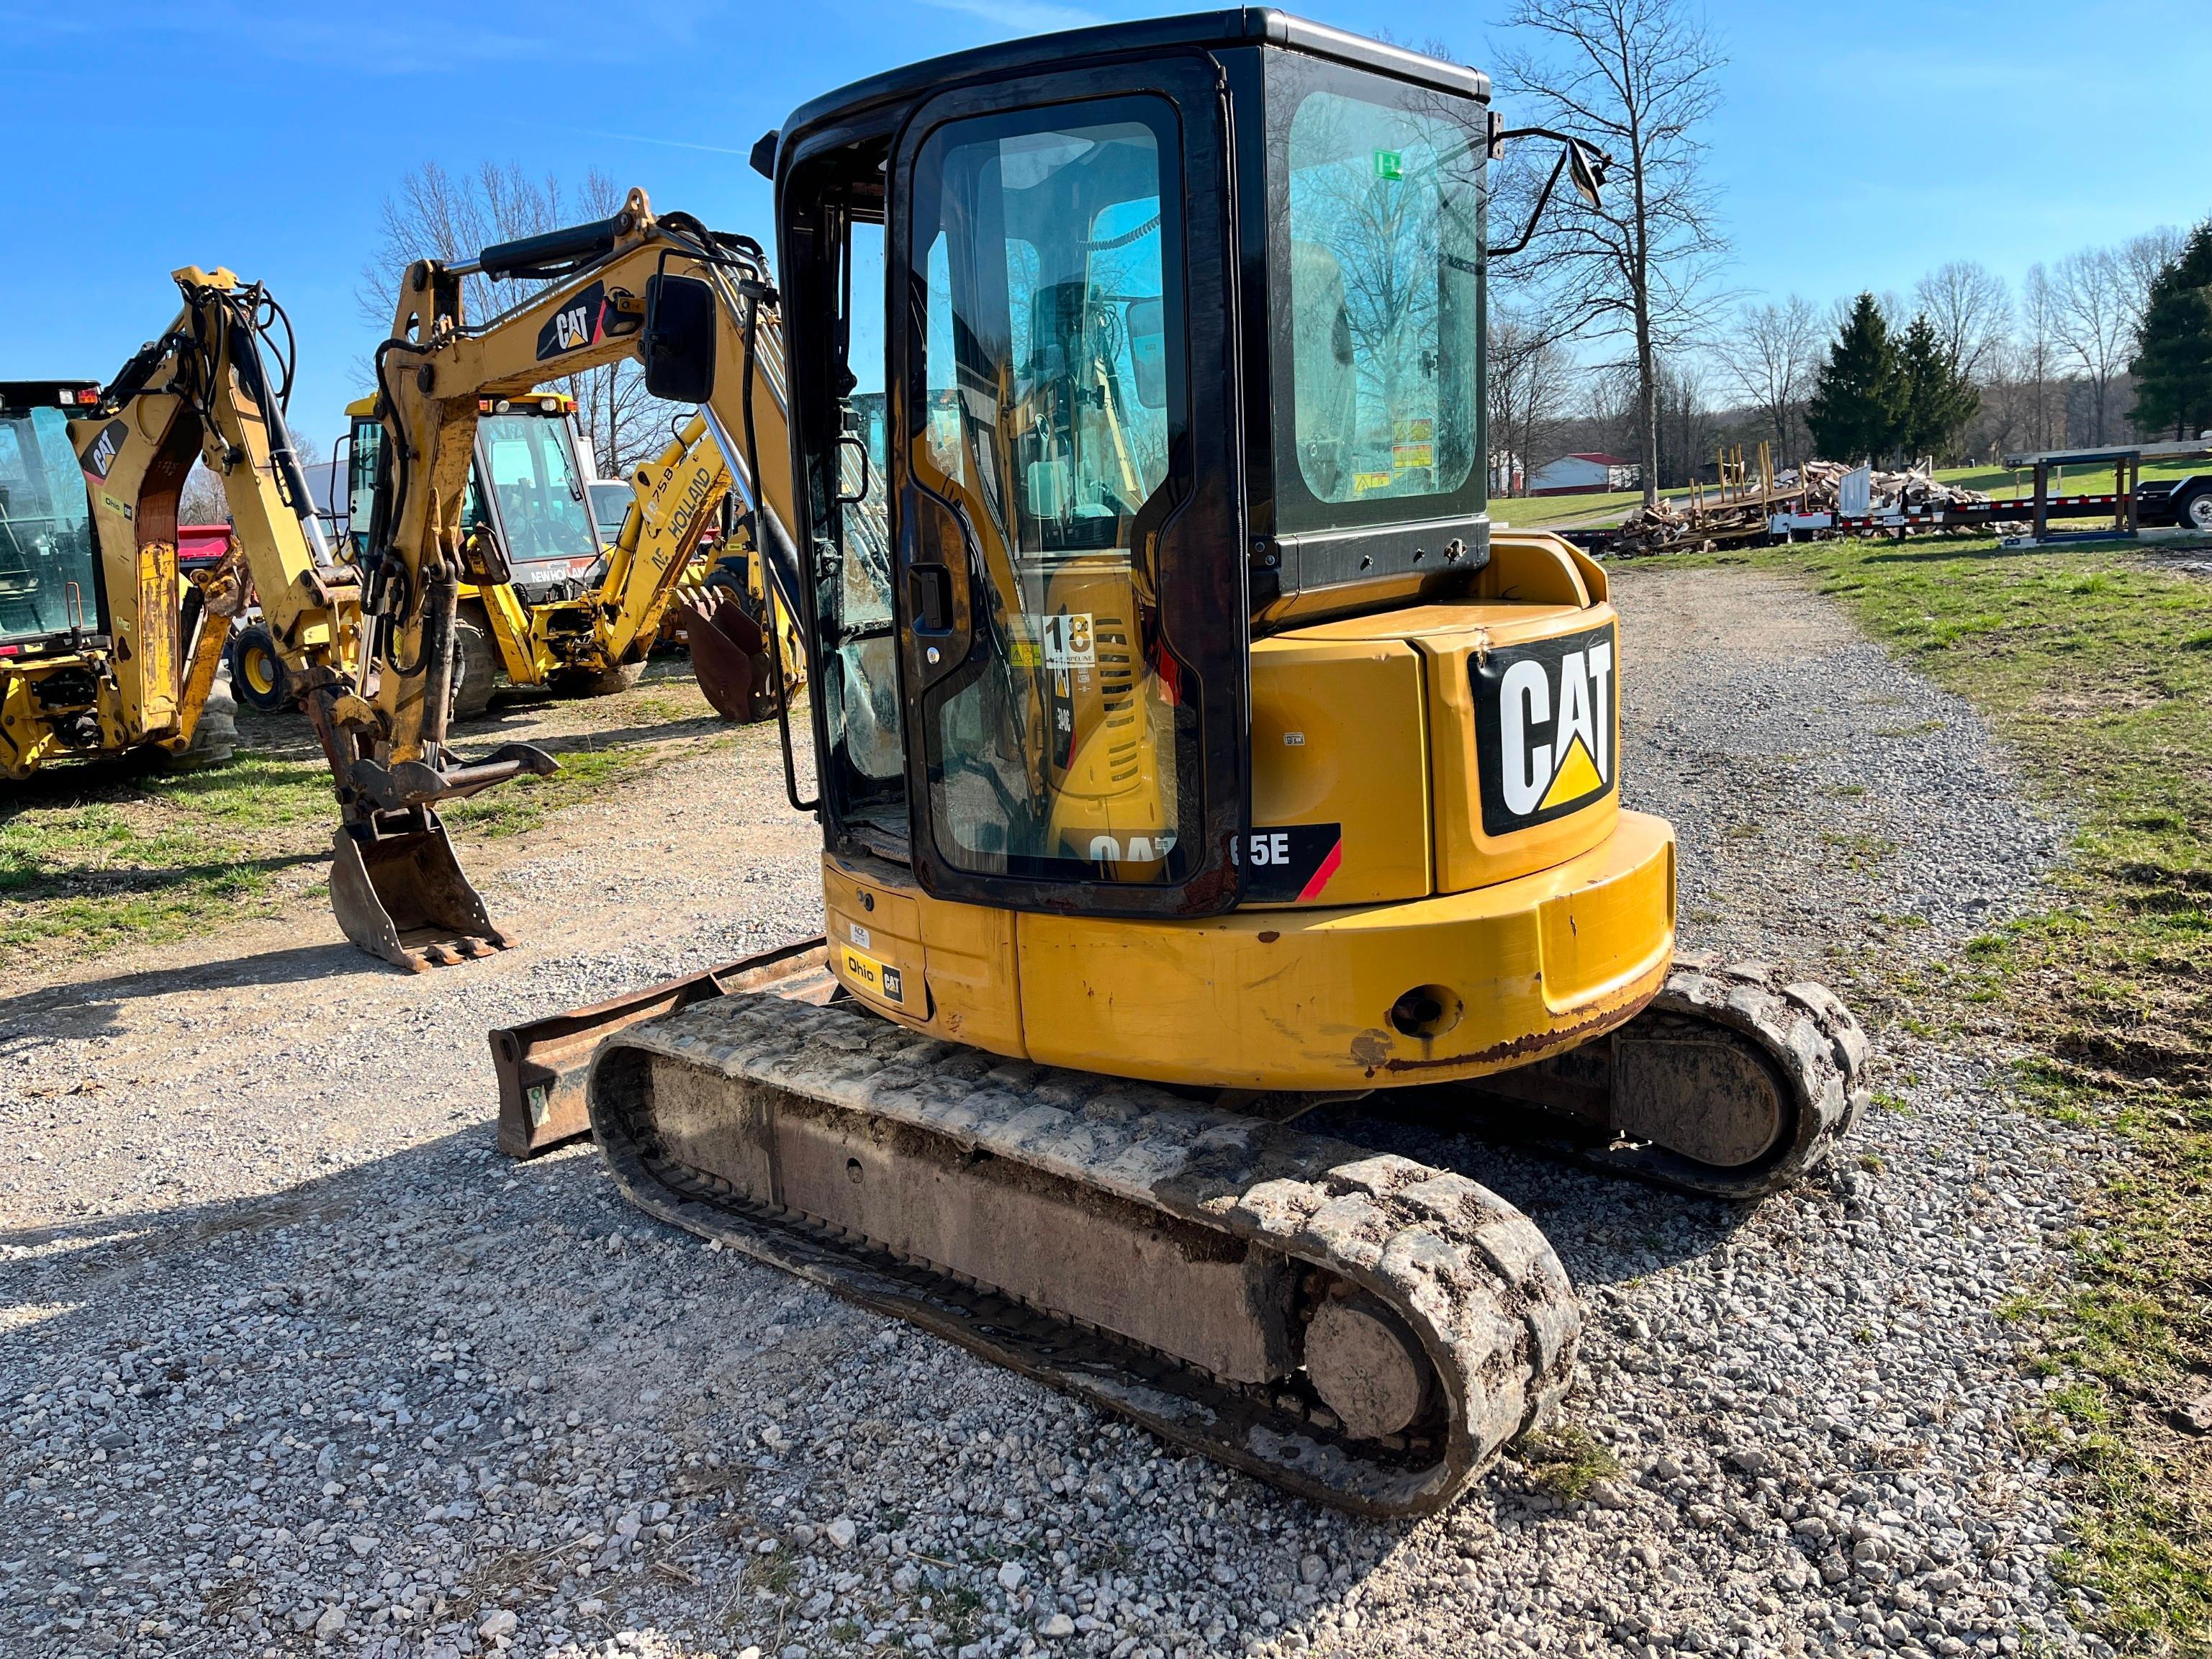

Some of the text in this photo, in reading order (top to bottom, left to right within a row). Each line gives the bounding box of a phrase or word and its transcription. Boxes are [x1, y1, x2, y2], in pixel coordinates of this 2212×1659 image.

[556, 307, 588, 349] CAT
[93, 430, 116, 476] CAT
[105, 497, 120, 510] Ohio
[668, 468, 710, 538] HOLLAND
[531, 571, 550, 582] NEW
[1045, 615, 1091, 653] 18
[1500, 641, 1611, 815] CAT
[848, 956, 899, 993] Ohio CAT
